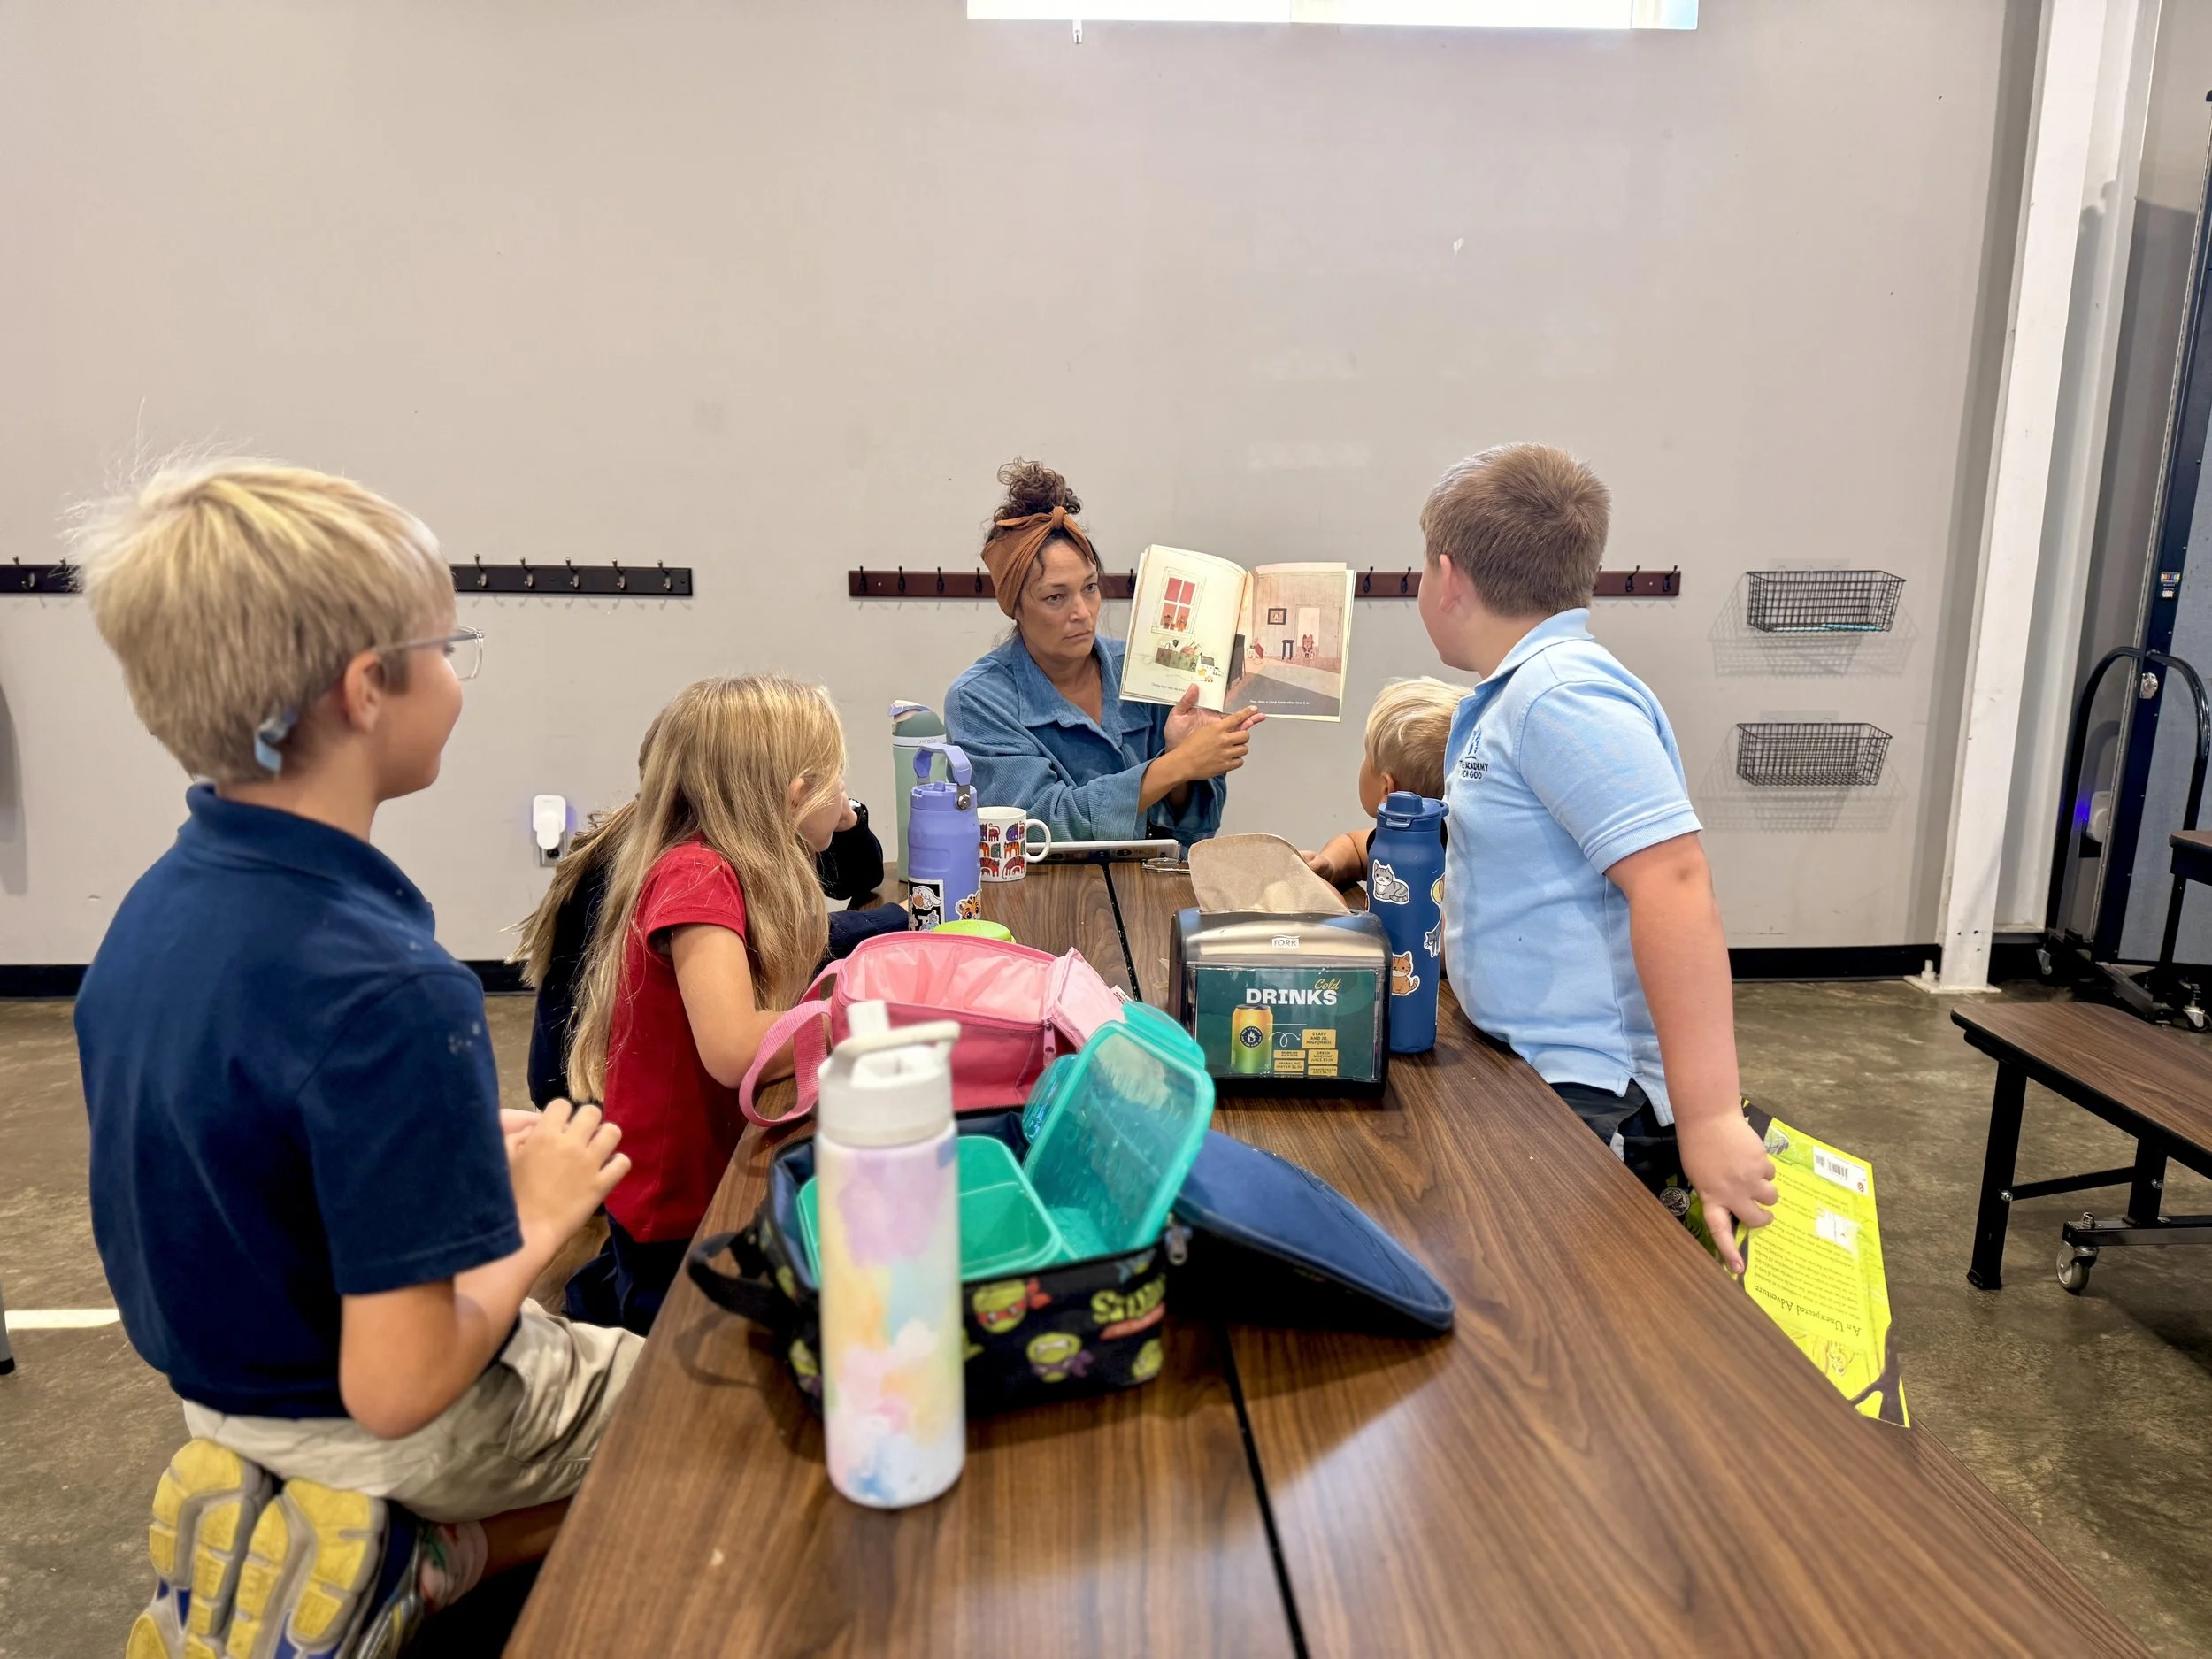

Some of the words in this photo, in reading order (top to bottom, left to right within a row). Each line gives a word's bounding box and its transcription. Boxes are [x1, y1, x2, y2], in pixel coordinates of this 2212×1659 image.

[1465, 762, 1488, 771] ACADEMY
[1315, 978, 1341, 990] Cold
[1246, 988, 1337, 1005] DRINKS
[1755, 1285, 1793, 1312] Adventure
[1796, 1304, 1845, 1333] Unexpected
[1847, 1324, 1862, 1336] An
